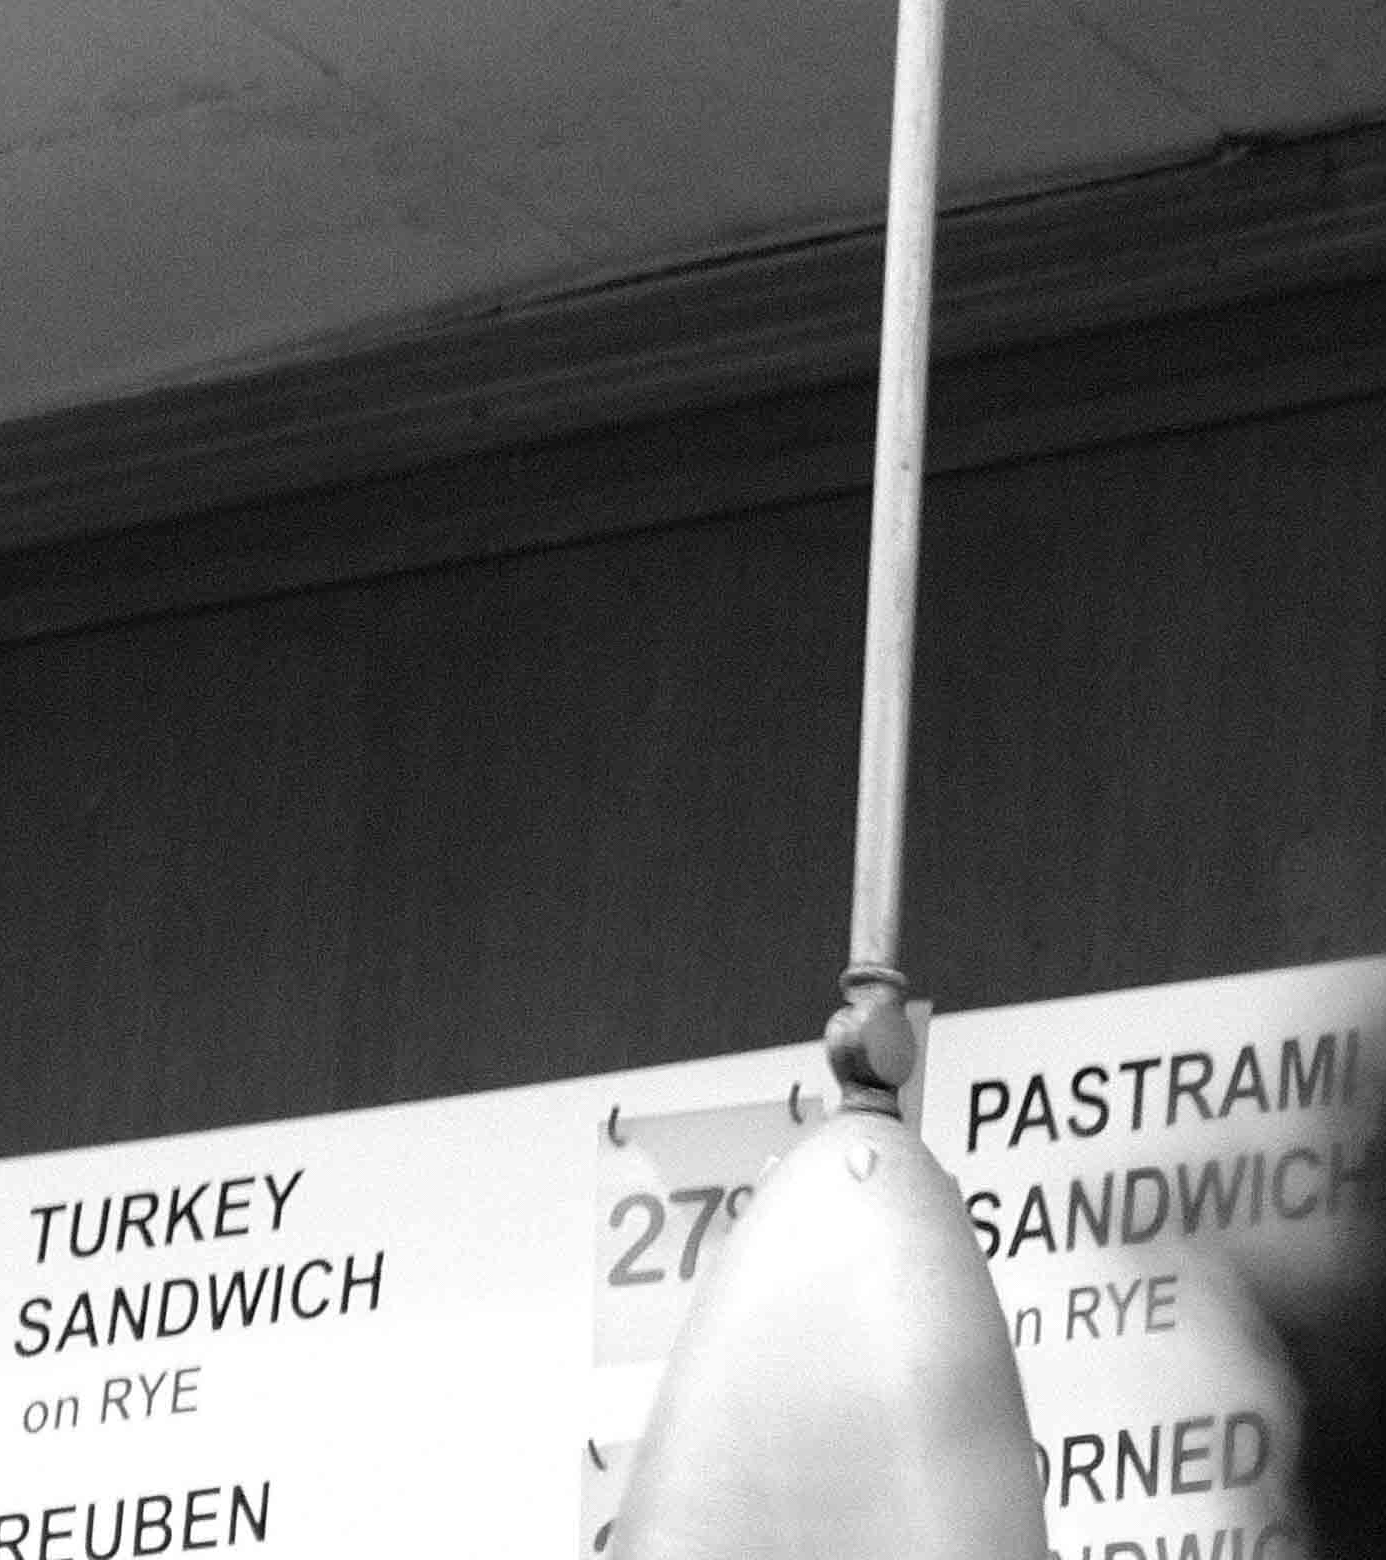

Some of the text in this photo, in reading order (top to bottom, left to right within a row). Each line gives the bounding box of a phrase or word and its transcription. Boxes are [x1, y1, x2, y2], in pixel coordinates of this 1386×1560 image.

[966, 1028, 1361, 1153] PASTRAMI
[29, 1168, 307, 1265] TURKEY
[13, 1250, 385, 1359] SANDWICH
[1066, 1274, 1179, 1341] RYE
[22, 1367, 203, 1435] on RYE
[1035, 1410, 1270, 1509] RNED
